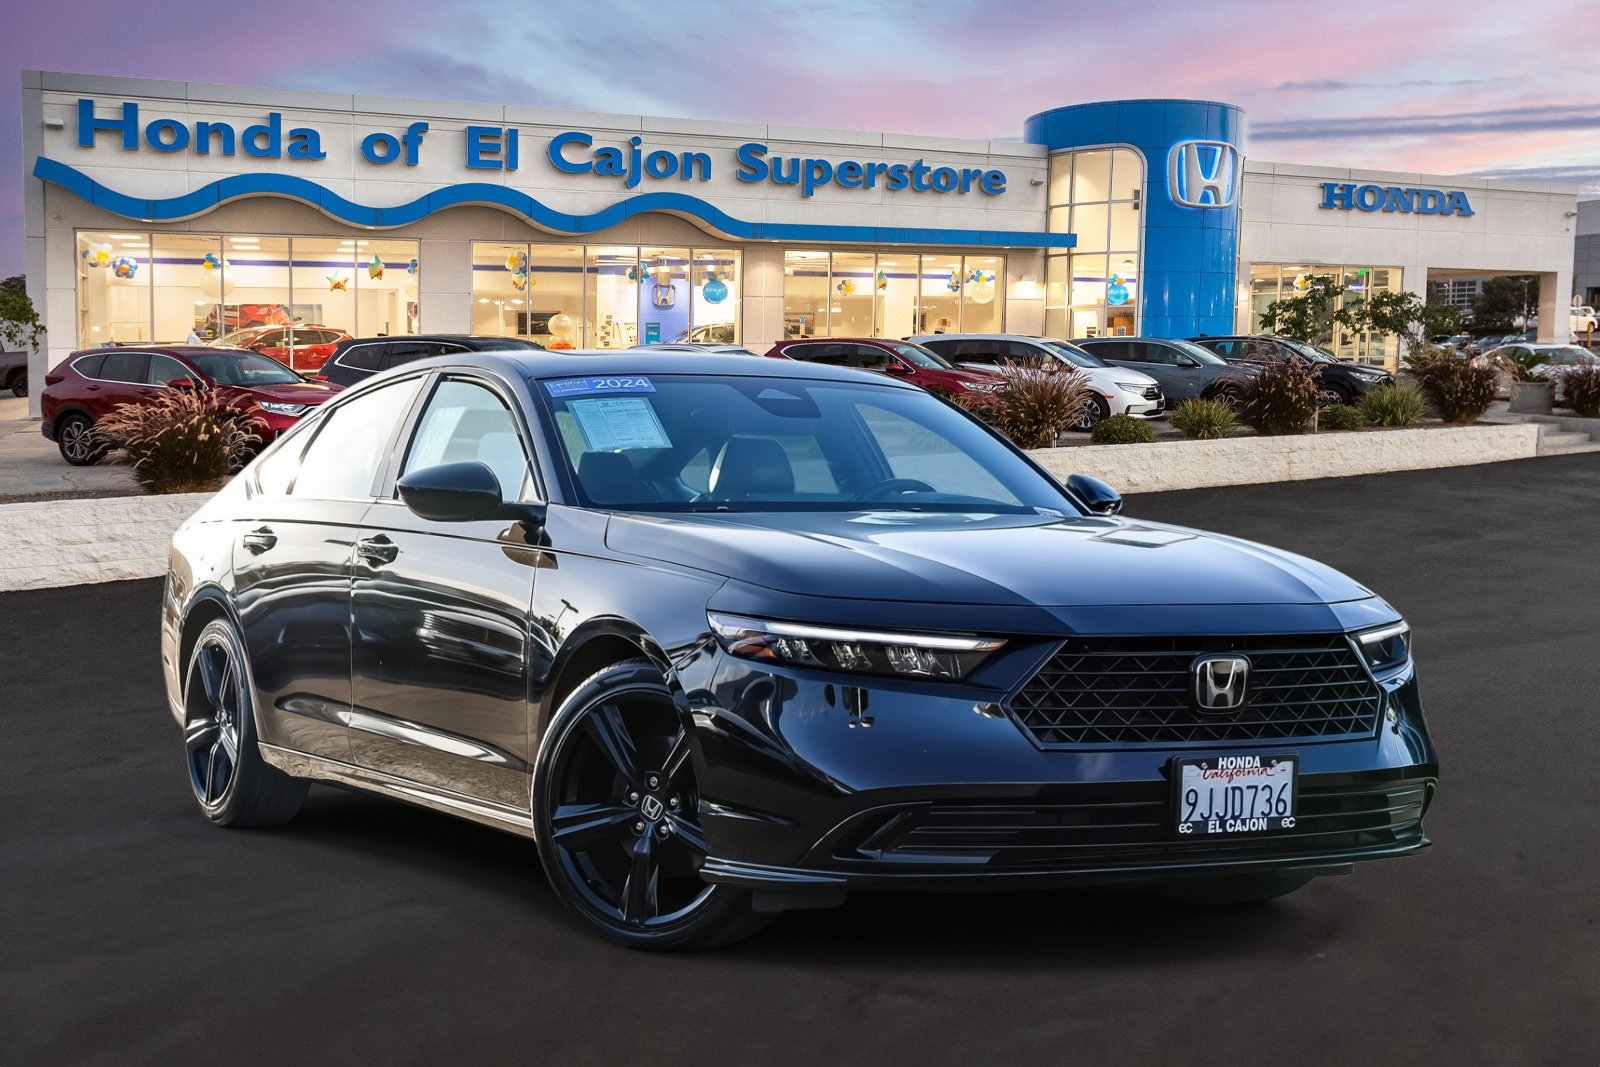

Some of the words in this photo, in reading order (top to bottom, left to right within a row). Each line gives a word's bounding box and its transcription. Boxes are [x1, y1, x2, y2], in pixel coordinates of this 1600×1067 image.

[78, 99, 327, 161] Honda
[361, 122, 430, 166] of
[466, 126, 518, 170] El
[548, 132, 712, 187] Cajon
[736, 143, 1007, 197] Superstore
[1319, 182, 1475, 217] HONDA
[593, 378, 650, 389] 2024
[1218, 756, 1261, 769] HONDA
[1184, 782, 1289, 822] 9JJD736
[1208, 820, 1223, 833] EL
[1226, 818, 1268, 832] CAJON
